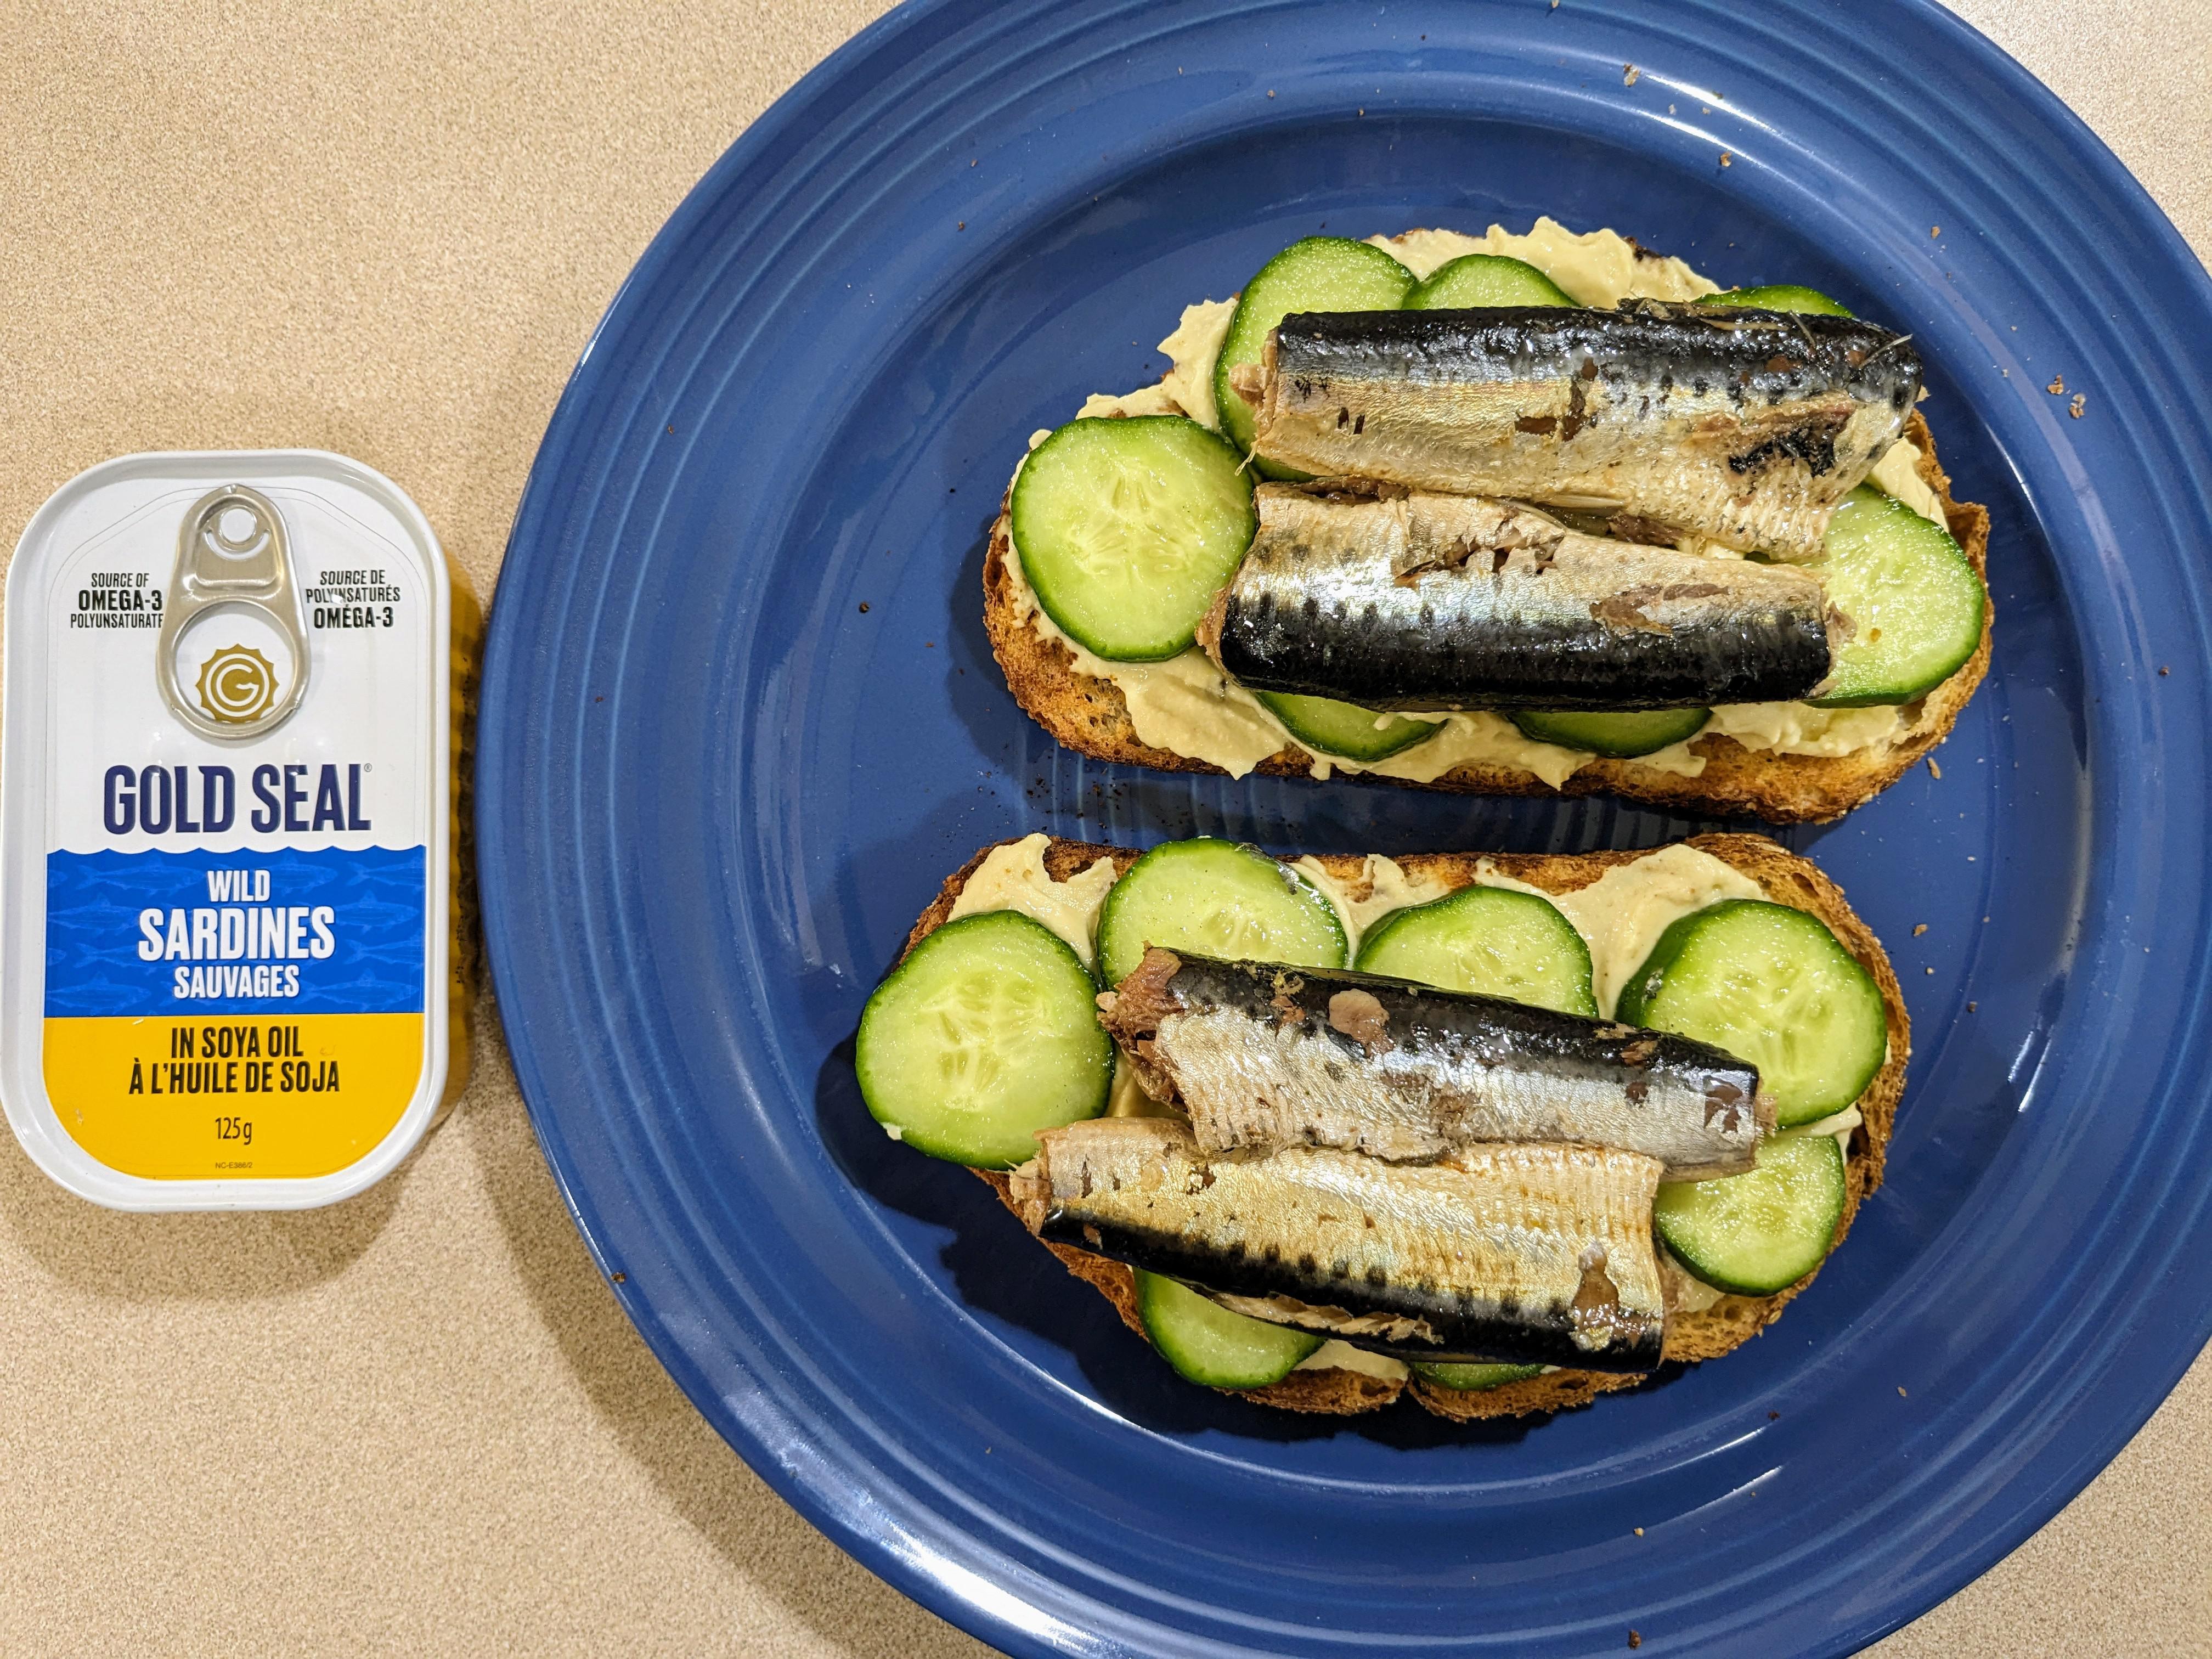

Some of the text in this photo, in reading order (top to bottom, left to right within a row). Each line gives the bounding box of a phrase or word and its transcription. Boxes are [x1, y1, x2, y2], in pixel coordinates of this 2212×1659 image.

[91, 573, 150, 588] SOURCE OF
[320, 569, 386, 585] SOURCE DE
[78, 590, 163, 611] OMEGA-3
[314, 604, 394, 629] OMÉGA-3
[104, 765, 236, 834] GOLD
[207, 870, 271, 902] WILD
[138, 906, 336, 961] SARDINES
[174, 964, 300, 999] SAUVAGES
[171, 1025, 304, 1058] IN SOYA OIL
[128, 1058, 144, 1094] À
[245, 1061, 274, 1092] DE
[280, 1060, 340, 1092] SOJA
